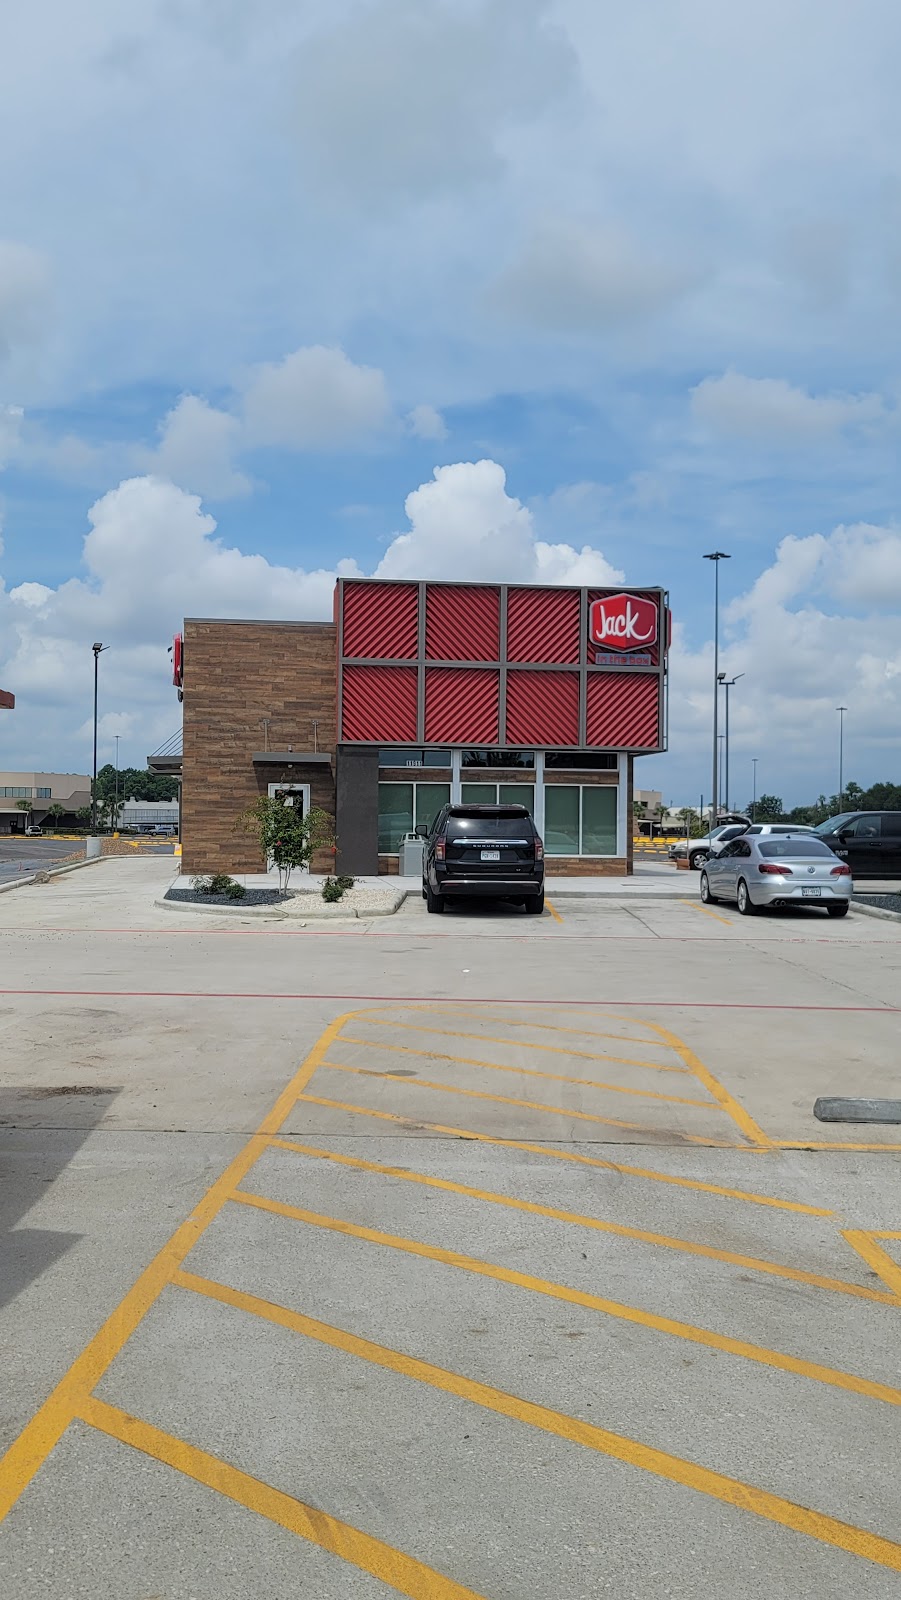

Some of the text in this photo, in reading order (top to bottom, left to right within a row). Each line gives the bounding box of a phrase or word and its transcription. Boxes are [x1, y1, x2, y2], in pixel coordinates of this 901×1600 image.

[596, 601, 653, 640] Jack
[609, 654, 627, 665] the
[629, 655, 649, 666] box
